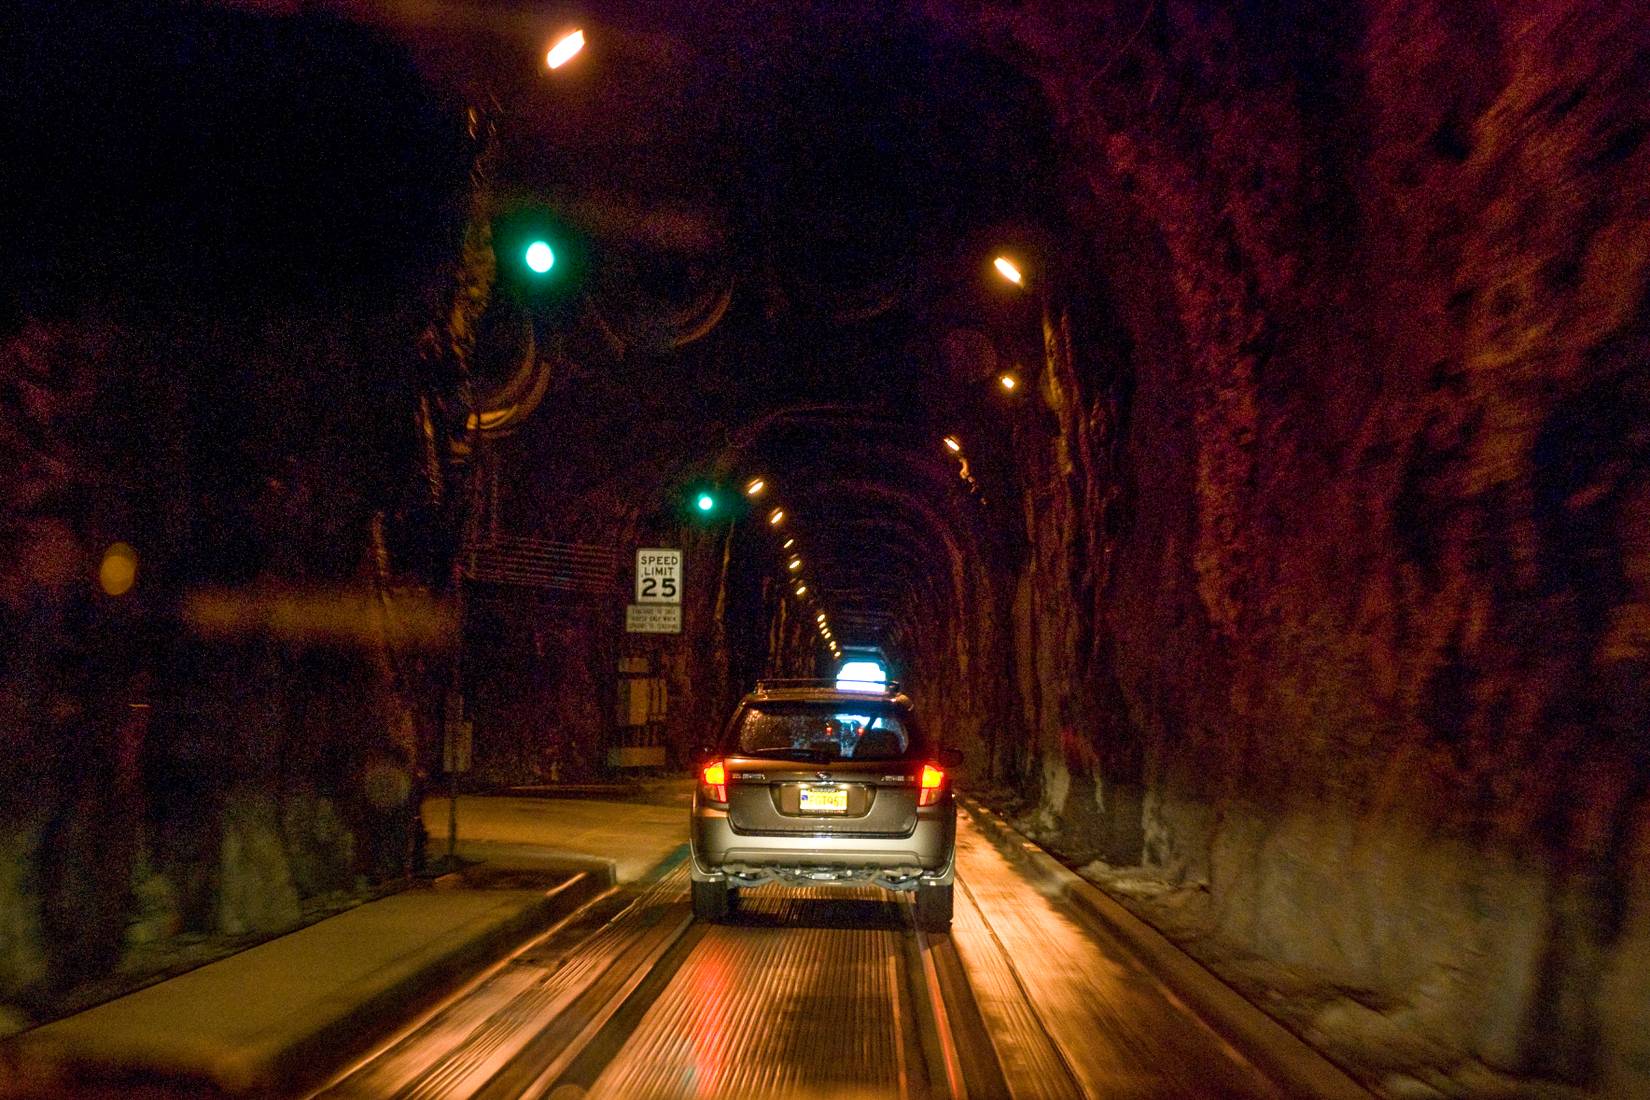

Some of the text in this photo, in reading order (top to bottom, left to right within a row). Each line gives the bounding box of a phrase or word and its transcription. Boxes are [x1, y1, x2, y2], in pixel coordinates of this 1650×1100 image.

[640, 556, 678, 565] SPEED
[644, 567, 674, 576] LIMIT
[641, 578, 676, 597] 25
